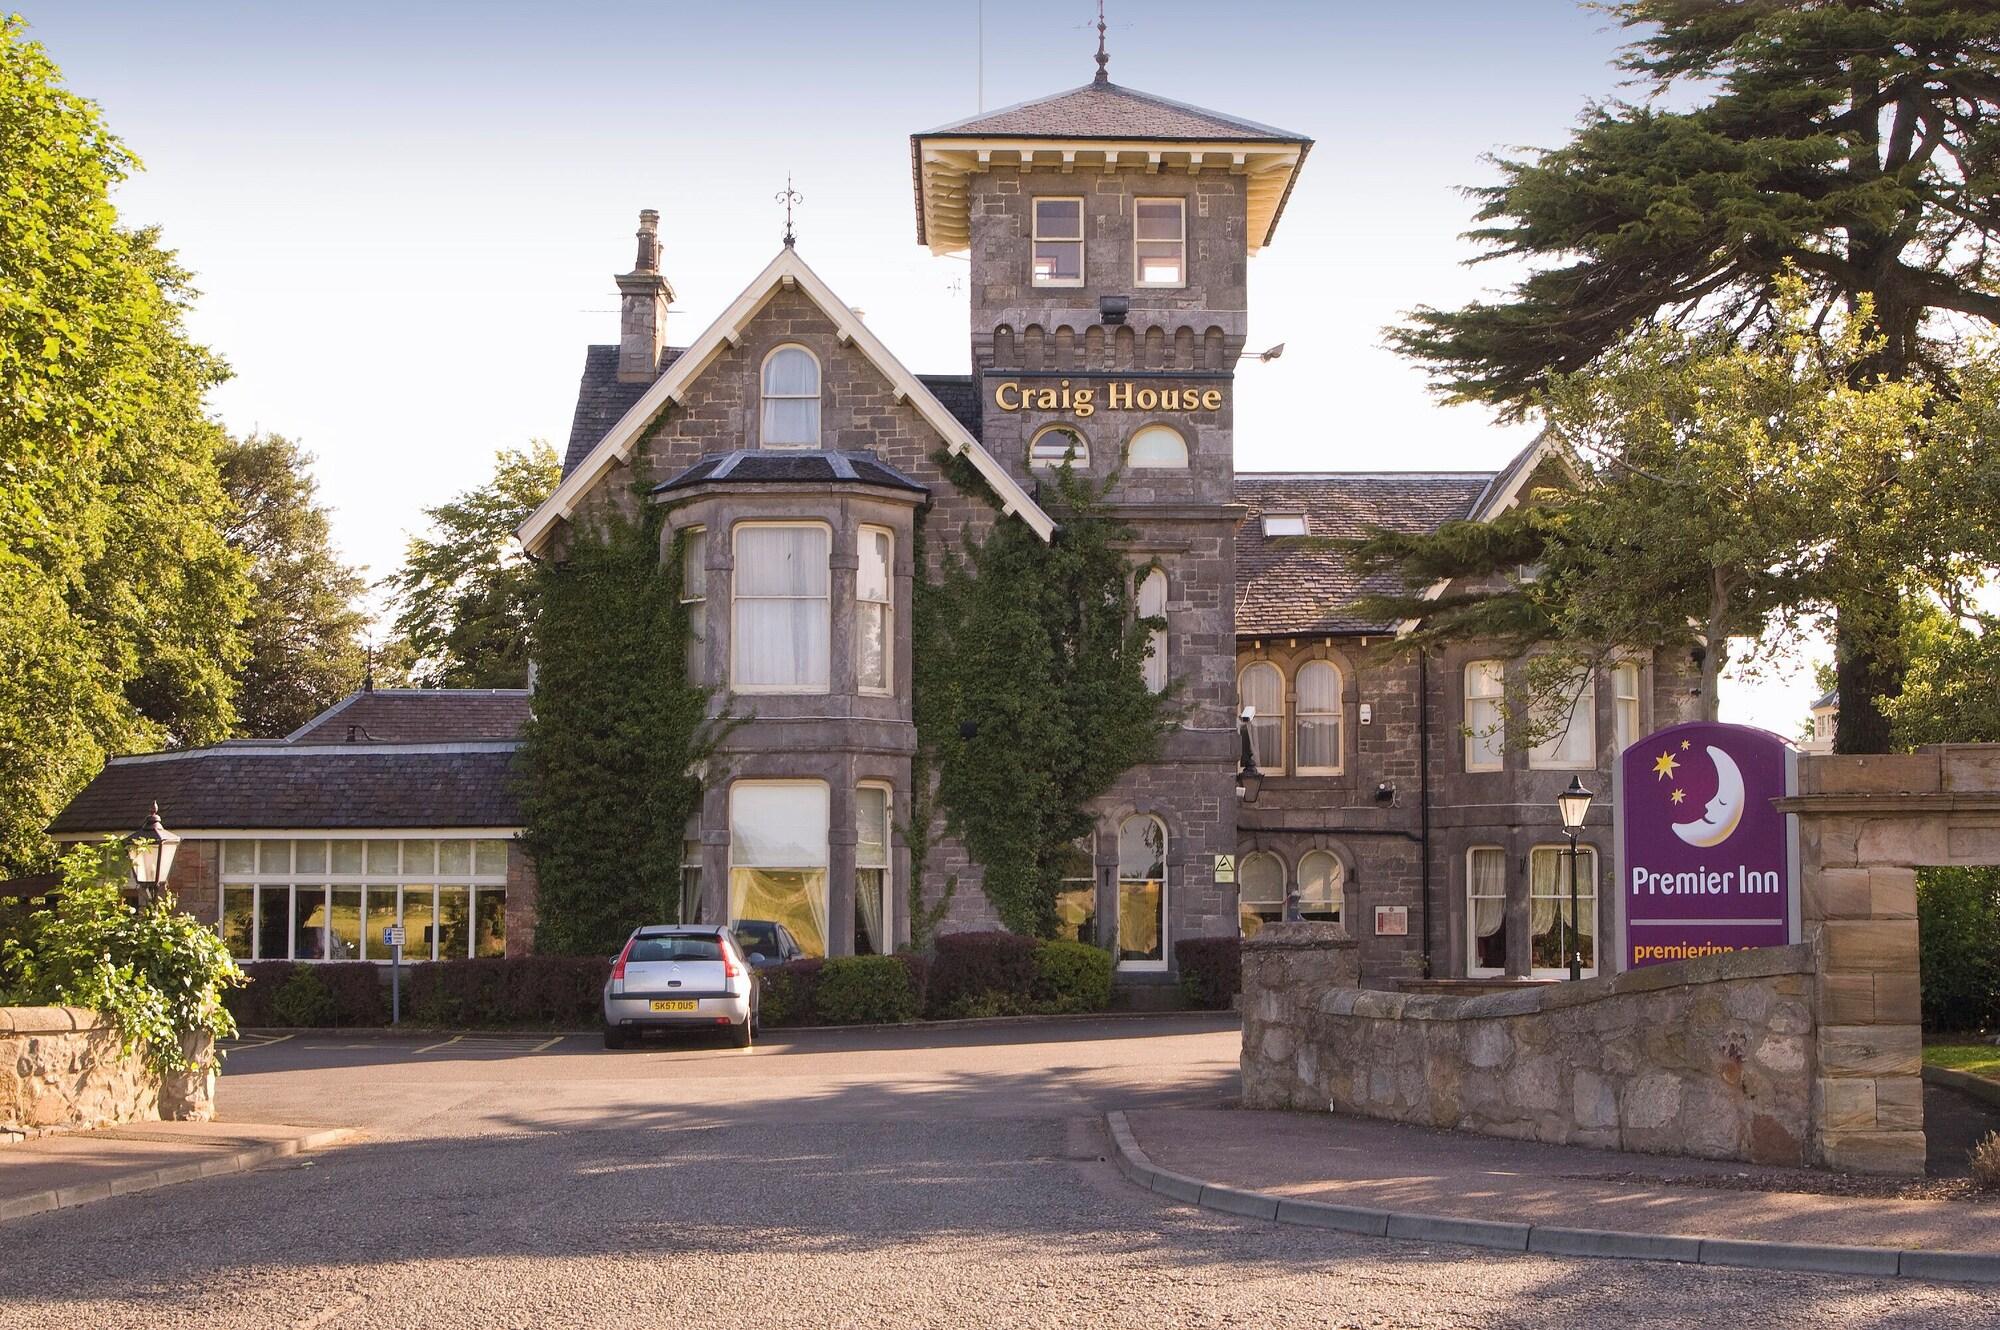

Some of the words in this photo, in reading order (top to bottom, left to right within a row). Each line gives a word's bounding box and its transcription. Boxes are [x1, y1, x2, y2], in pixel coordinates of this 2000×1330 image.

[995, 380, 1094, 417] Craig
[1108, 382, 1222, 410] House
[1632, 866, 1734, 895] Premier
[1739, 865, 1779, 893] Inn
[1634, 941, 1760, 964] premierinn
[655, 1002, 676, 1010] SK57
